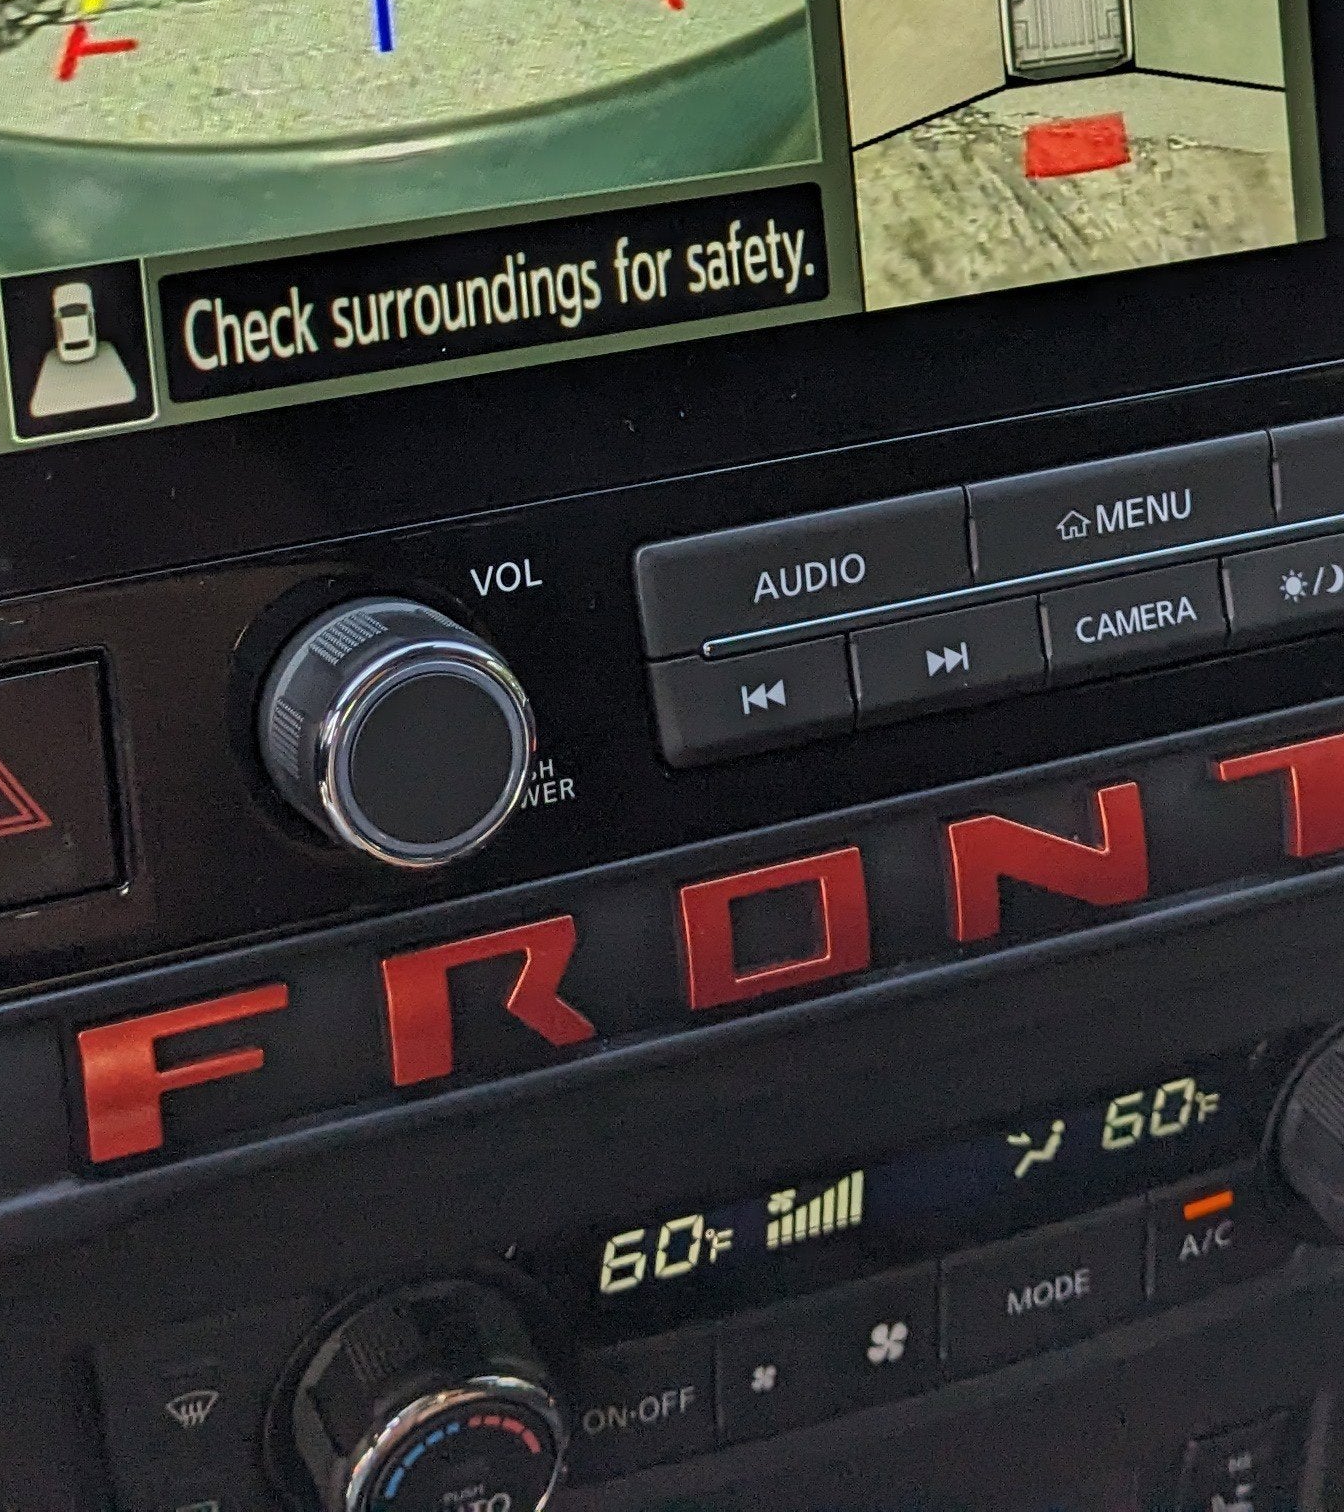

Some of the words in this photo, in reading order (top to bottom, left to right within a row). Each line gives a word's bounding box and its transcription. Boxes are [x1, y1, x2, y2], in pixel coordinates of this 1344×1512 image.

[183, 286, 319, 371] Check
[331, 251, 601, 350] surroundings
[613, 236, 673, 304] for
[688, 218, 817, 294] safety.
[1094, 488, 1193, 536] MENU
[470, 558, 543, 597] VOL
[752, 553, 866, 604] AUDIO
[1075, 596, 1197, 644] CAMERA
[1178, 1221, 1233, 1263] A/C
[1006, 1267, 1092, 1318] MODE
